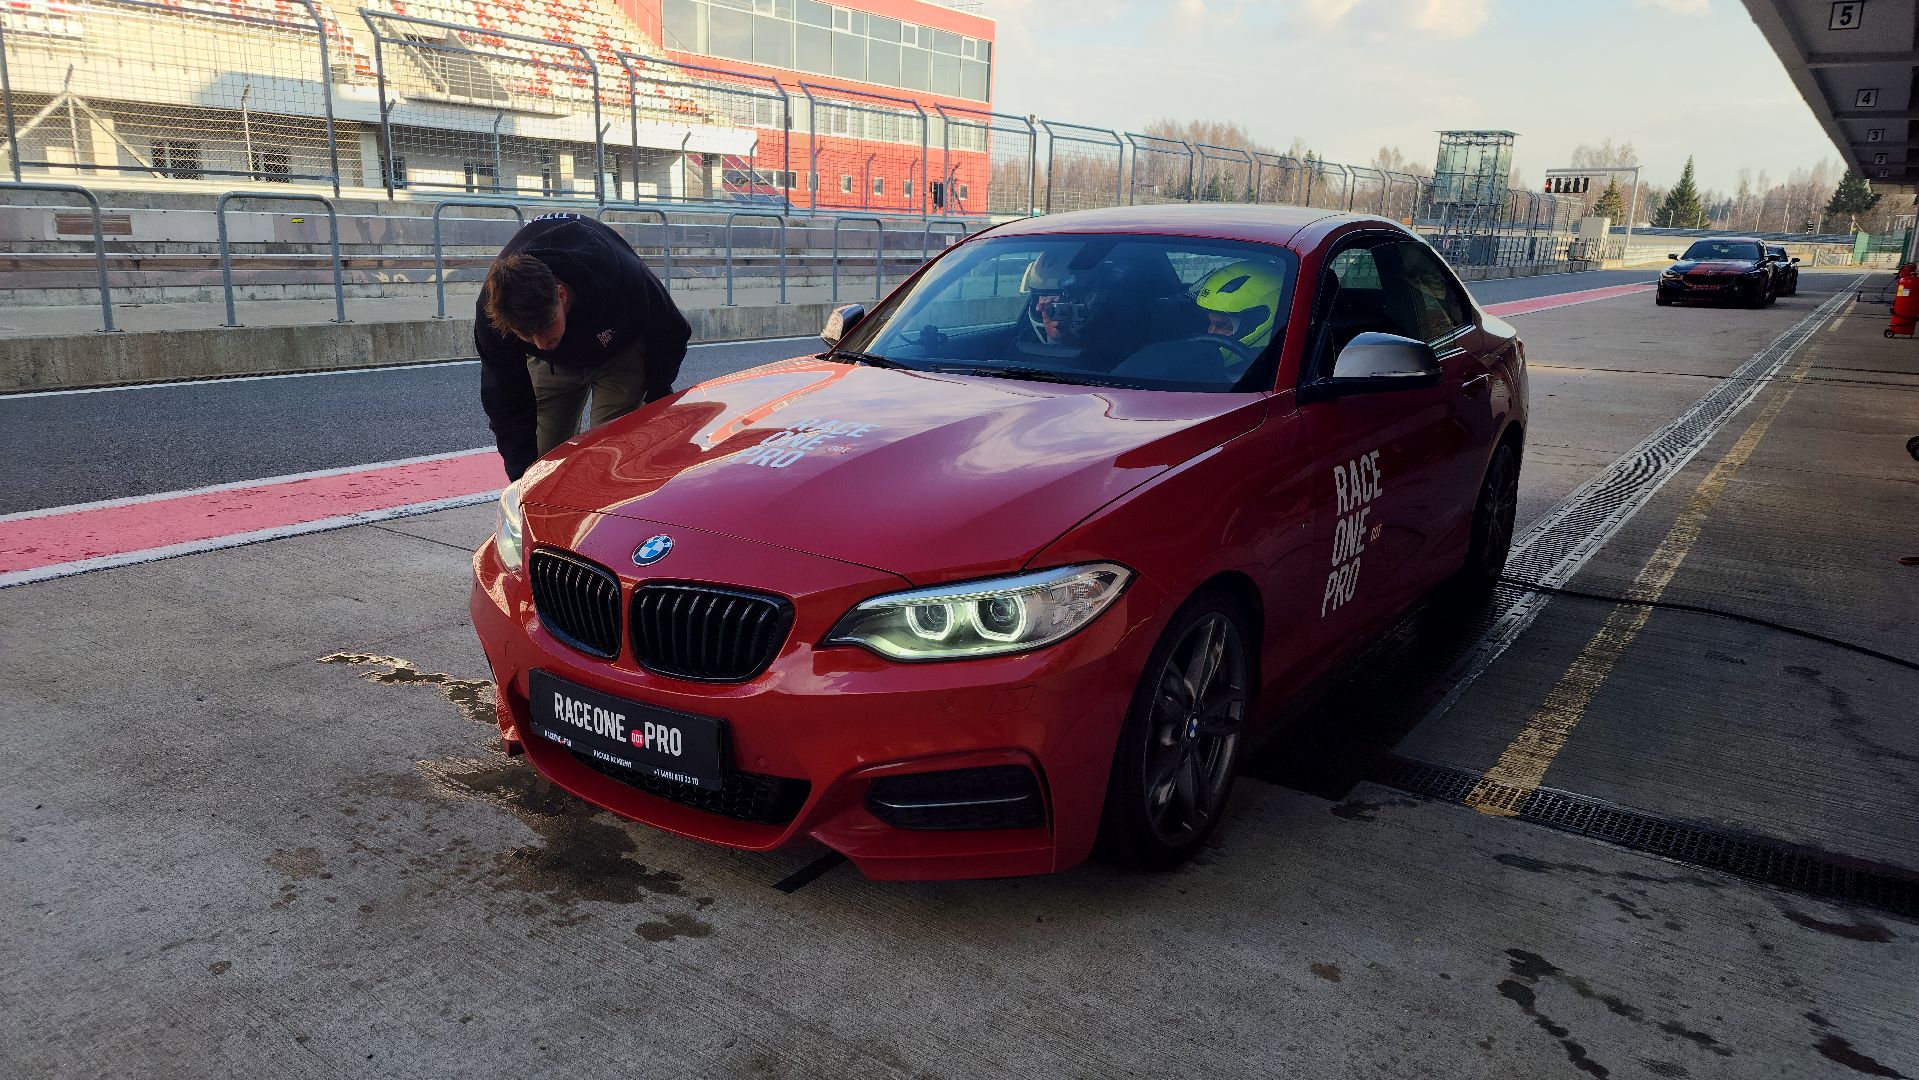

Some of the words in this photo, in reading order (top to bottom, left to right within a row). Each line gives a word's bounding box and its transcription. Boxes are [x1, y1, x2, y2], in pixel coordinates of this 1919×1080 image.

[1839, 6, 1853, 26] 5
[1862, 91, 1872, 105] 4
[1871, 130, 1880, 141] 3
[785, 418, 883, 438] RACE
[760, 431, 837, 451] ONE
[727, 445, 806, 468] PRO
[1333, 450, 1383, 516] RACE
[1331, 506, 1371, 567] ONE
[1320, 556, 1361, 618] PRO
[554, 691, 627, 743] RACEONE
[631, 732, 644, 744] DOT
[644, 721, 682, 757] PRO
